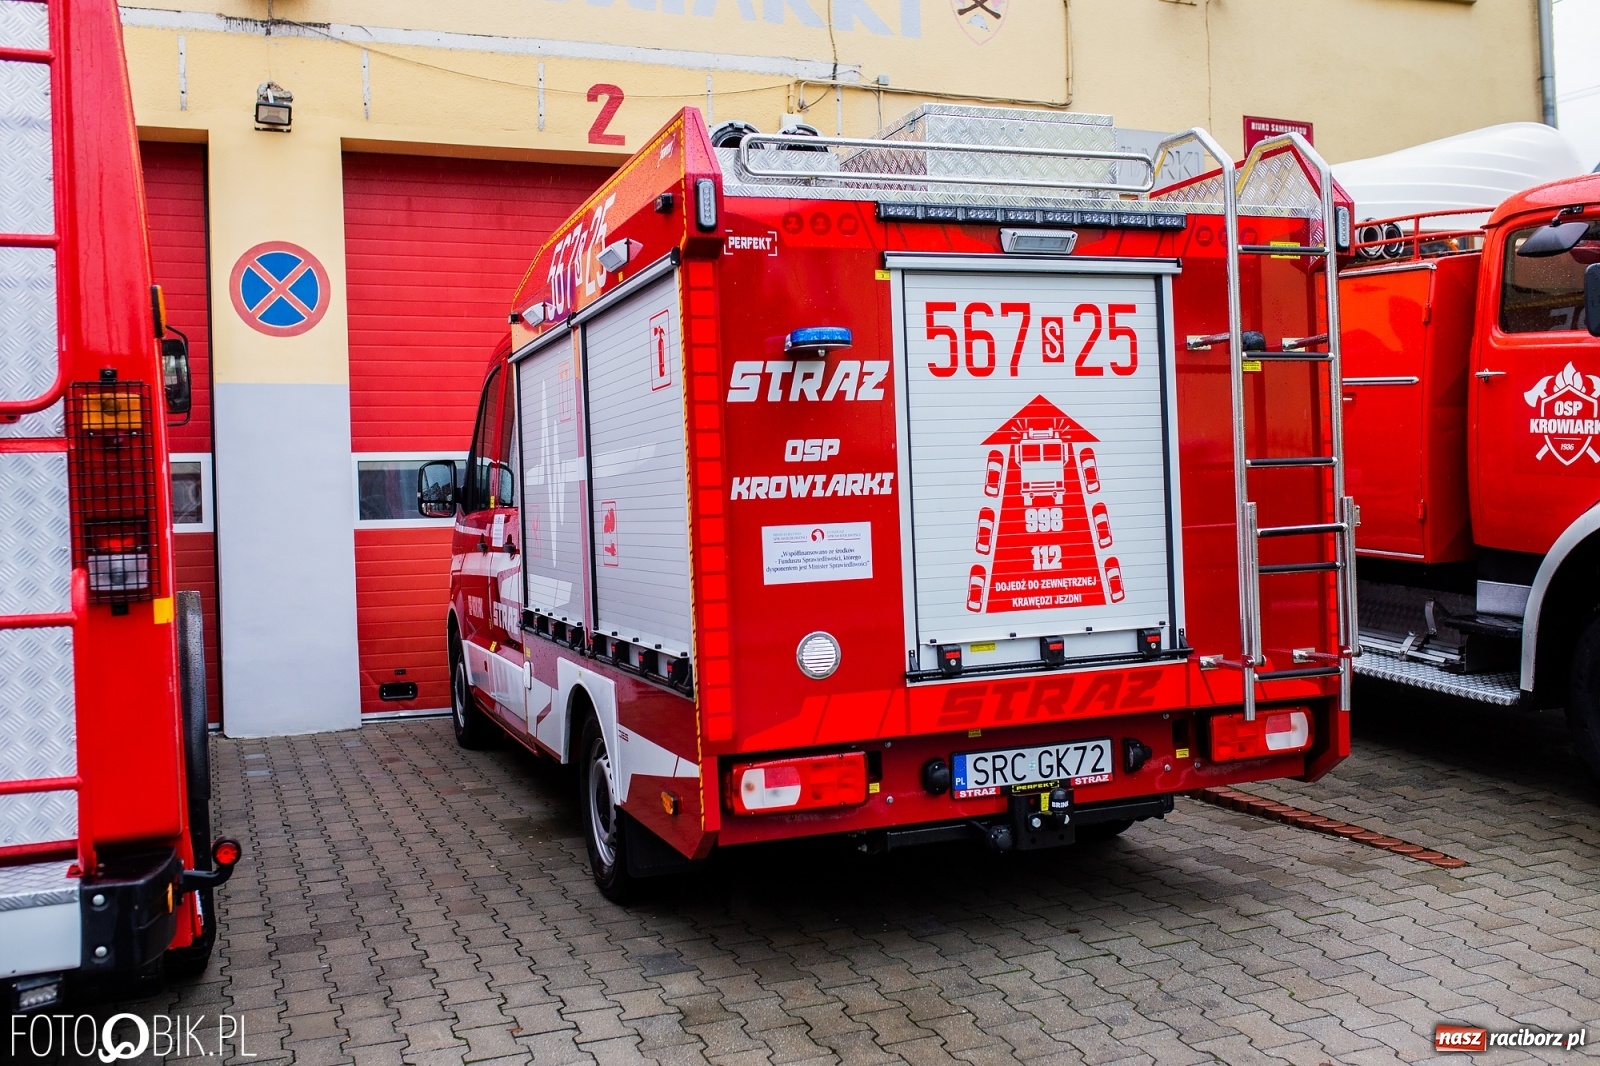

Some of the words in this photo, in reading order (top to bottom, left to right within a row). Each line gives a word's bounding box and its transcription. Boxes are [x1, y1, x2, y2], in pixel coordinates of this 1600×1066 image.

[586, 83, 625, 146] 2
[1251, 122, 1269, 131] BIURO
[728, 236, 773, 250] PERFEKT
[925, 301, 1031, 378] 567
[1044, 319, 1061, 359] S
[1073, 303, 1138, 377] 25
[1554, 400, 1583, 416] OSP
[784, 438, 840, 462] OSP
[730, 472, 894, 500] KROWIARKI
[1025, 507, 1063, 532] 998
[1031, 545, 1062, 570] 112
[798, 564, 808, 572] jest
[995, 578, 1026, 592] DOJEDŹ
[1028, 580, 1039, 589] DO
[1041, 576, 1097, 590] ZEWNĘTRZNEJ
[1012, 594, 1052, 608] KRAWĘDZI
[1054, 593, 1082, 605] JEZDNI
[973, 752, 1026, 786] SRC
[1037, 744, 1105, 779] GK72
[955, 777, 966, 786] PL
[1016, 781, 1055, 791] PERFEKT
